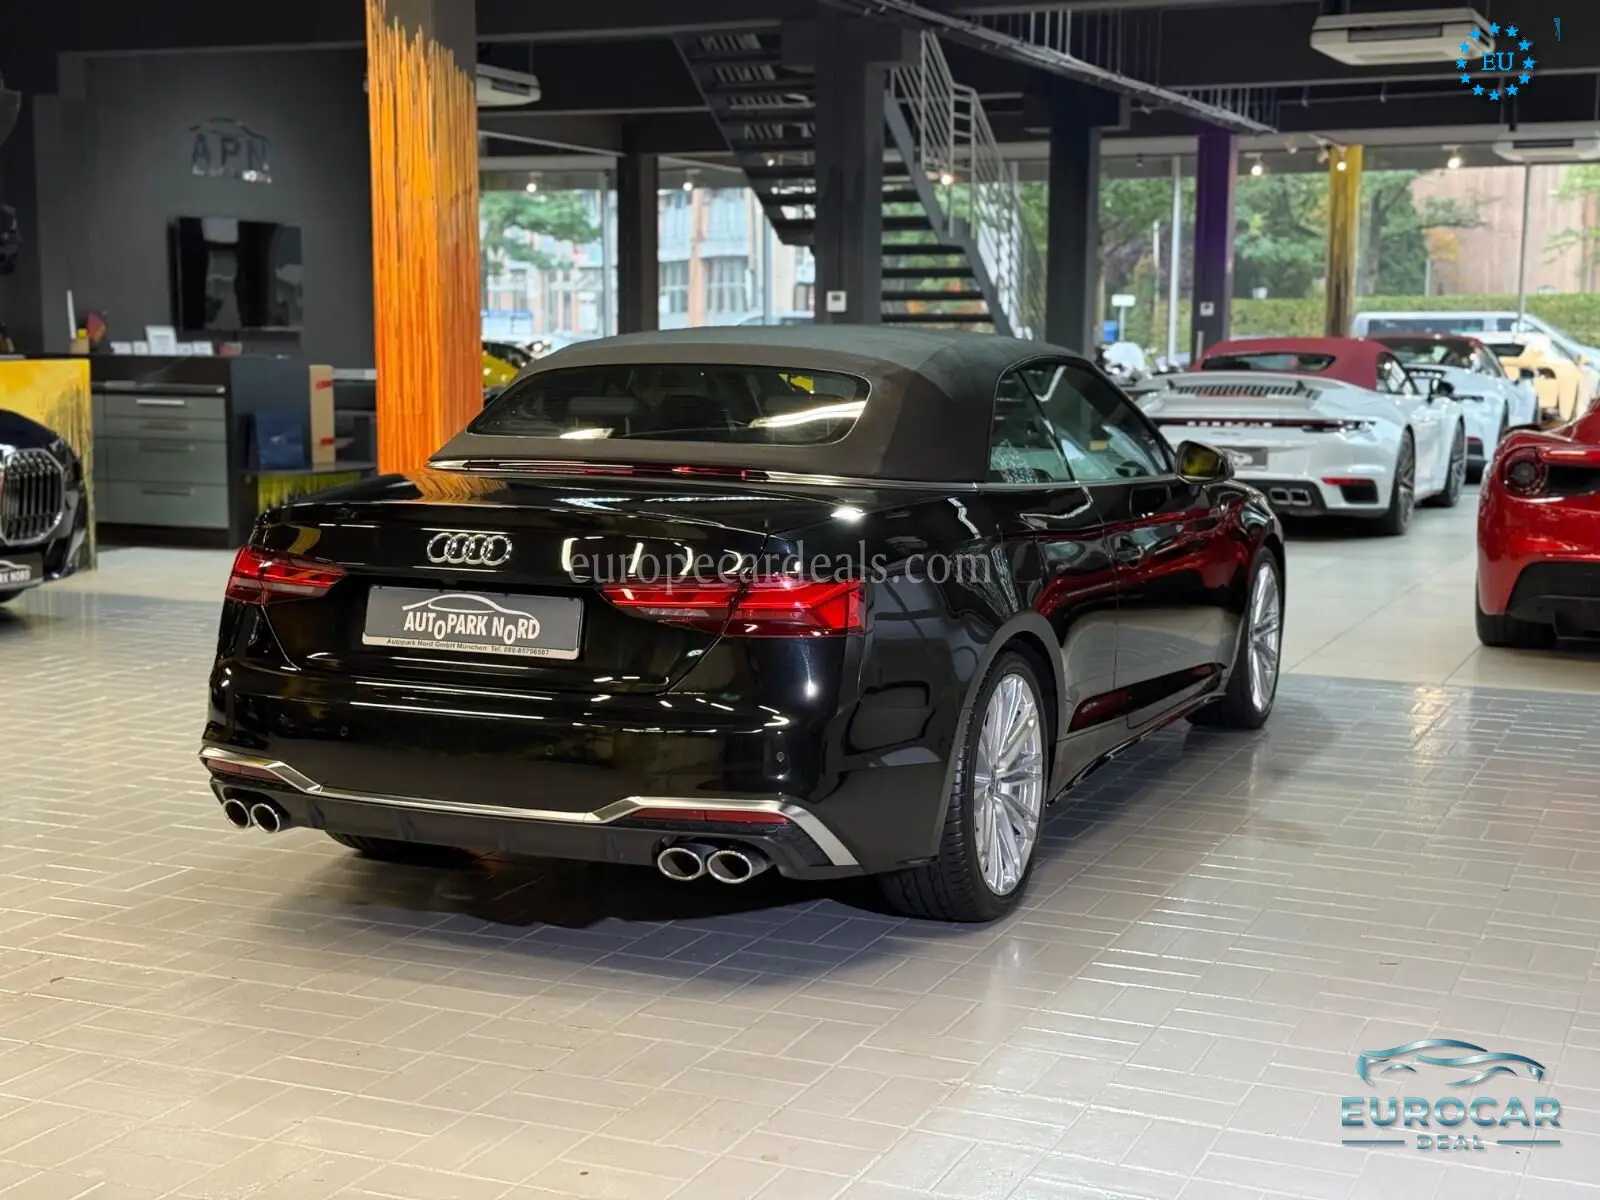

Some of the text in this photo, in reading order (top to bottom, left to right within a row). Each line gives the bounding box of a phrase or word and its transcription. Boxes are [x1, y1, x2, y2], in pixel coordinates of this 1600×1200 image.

[191, 132, 269, 170] APN
[387, 638, 416, 648] Autopark
[434, 641, 455, 649] GmbH
[456, 643, 488, 651] München
